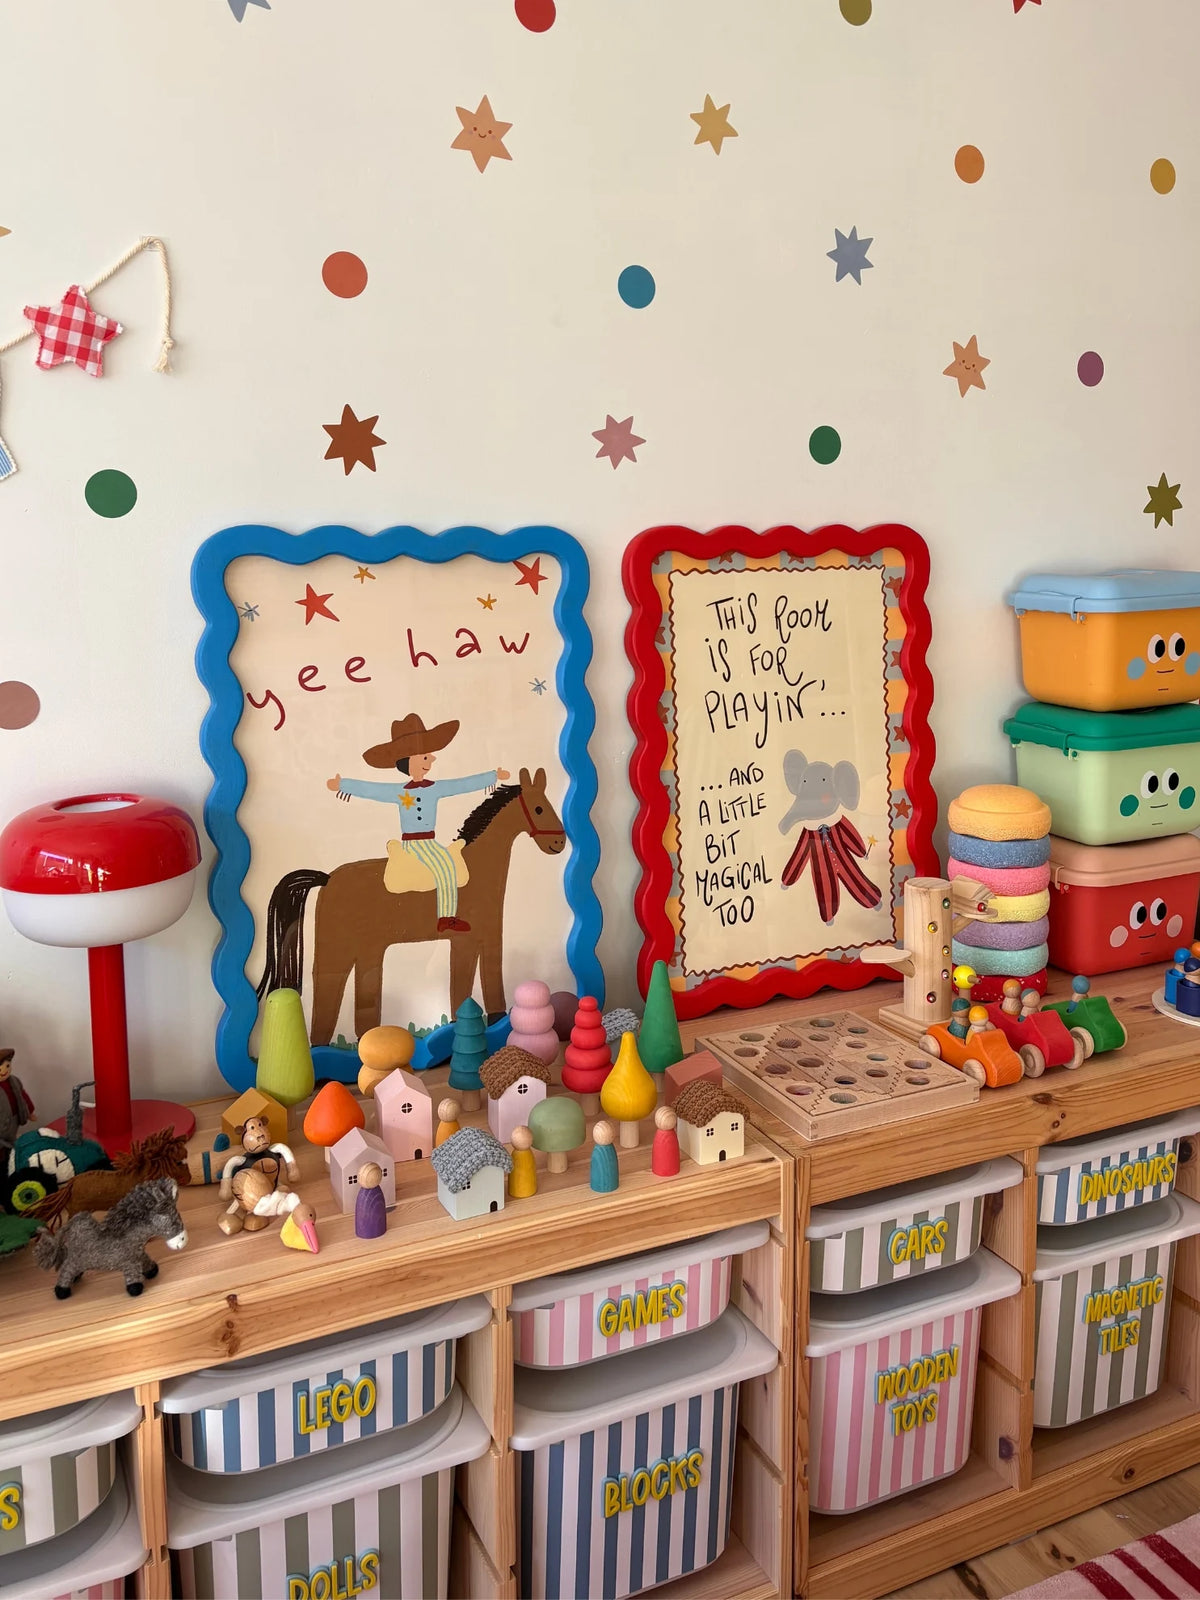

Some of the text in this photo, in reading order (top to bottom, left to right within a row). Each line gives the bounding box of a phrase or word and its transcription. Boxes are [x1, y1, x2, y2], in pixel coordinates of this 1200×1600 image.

[246, 627, 530, 731] yee haw
[749, 643, 804, 687] FOR
[698, 799, 711, 827] A
[712, 895, 755, 928] TOO
[1077, 1150, 1177, 1206] DINOSAURS
[888, 1218, 950, 1266] CARS
[598, 1281, 688, 1338] GAMES
[1083, 1275, 1165, 1326] MAGNETIC
[1098, 1317, 1142, 1356] TILES
[875, 1345, 961, 1405] WOODEN
[297, 1374, 378, 1436] LEGO
[890, 1391, 939, 1437] TOYS
[602, 1449, 704, 1519] BLOCKS
